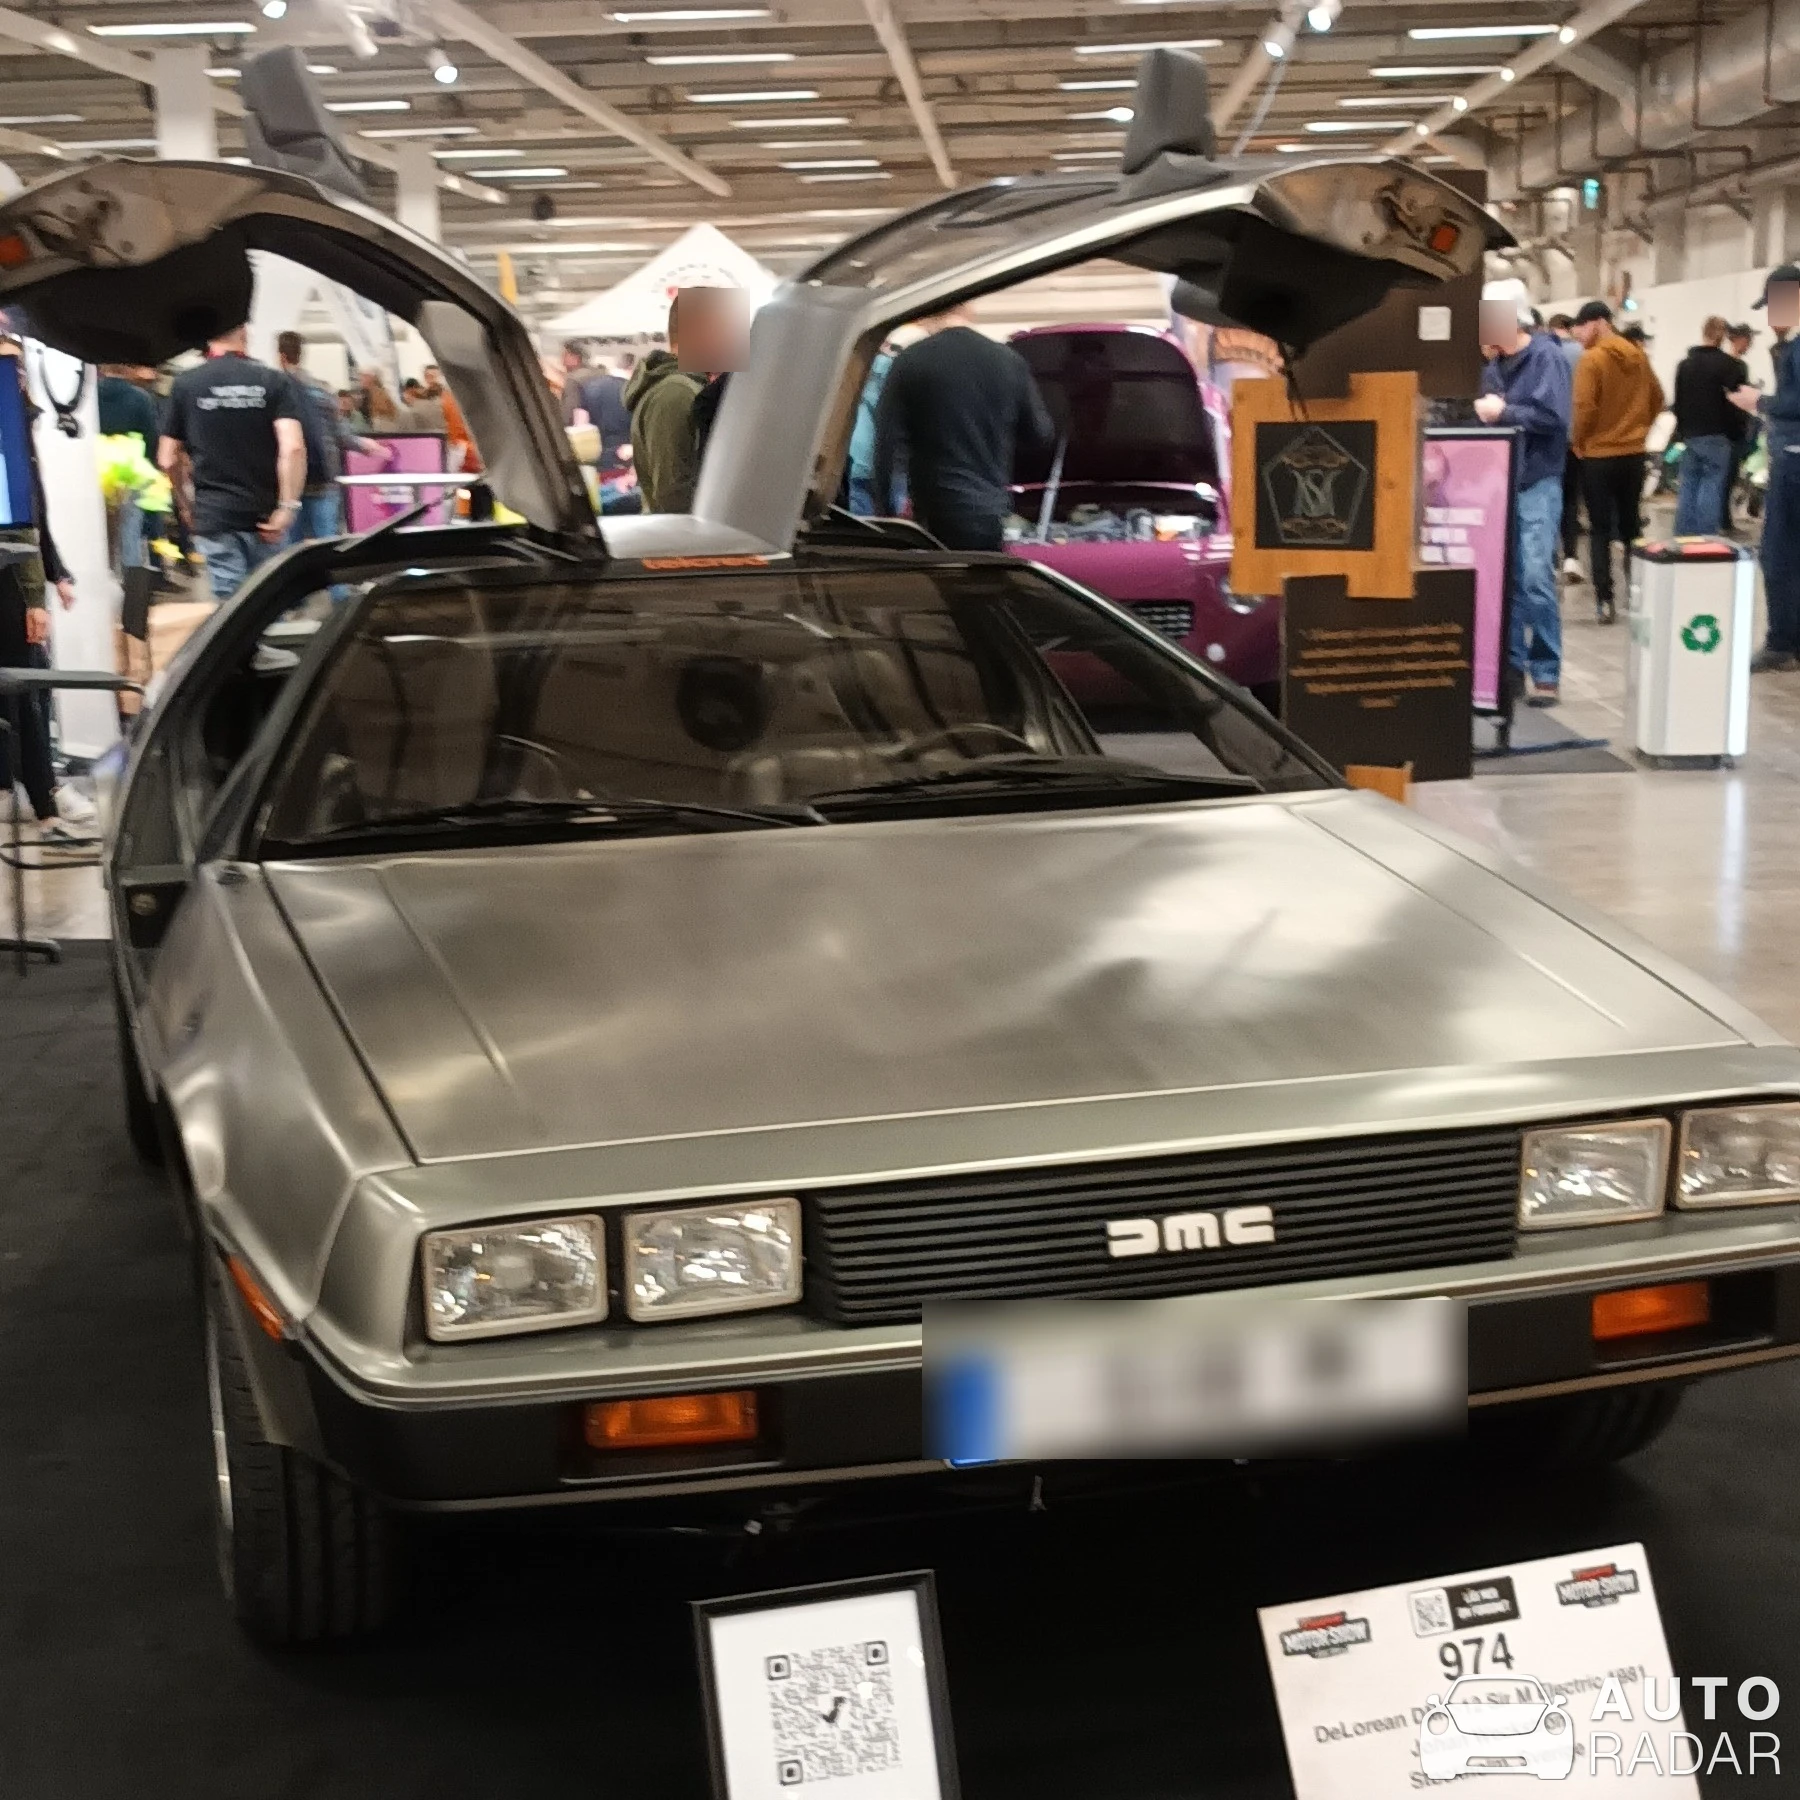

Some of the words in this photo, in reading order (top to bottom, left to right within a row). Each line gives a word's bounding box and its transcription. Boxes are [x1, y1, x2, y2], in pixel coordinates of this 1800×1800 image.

[1107, 1205, 1275, 1258] DMC
[1439, 1632, 1515, 1680] 974
[1314, 1712, 1407, 1743] DeLorean
